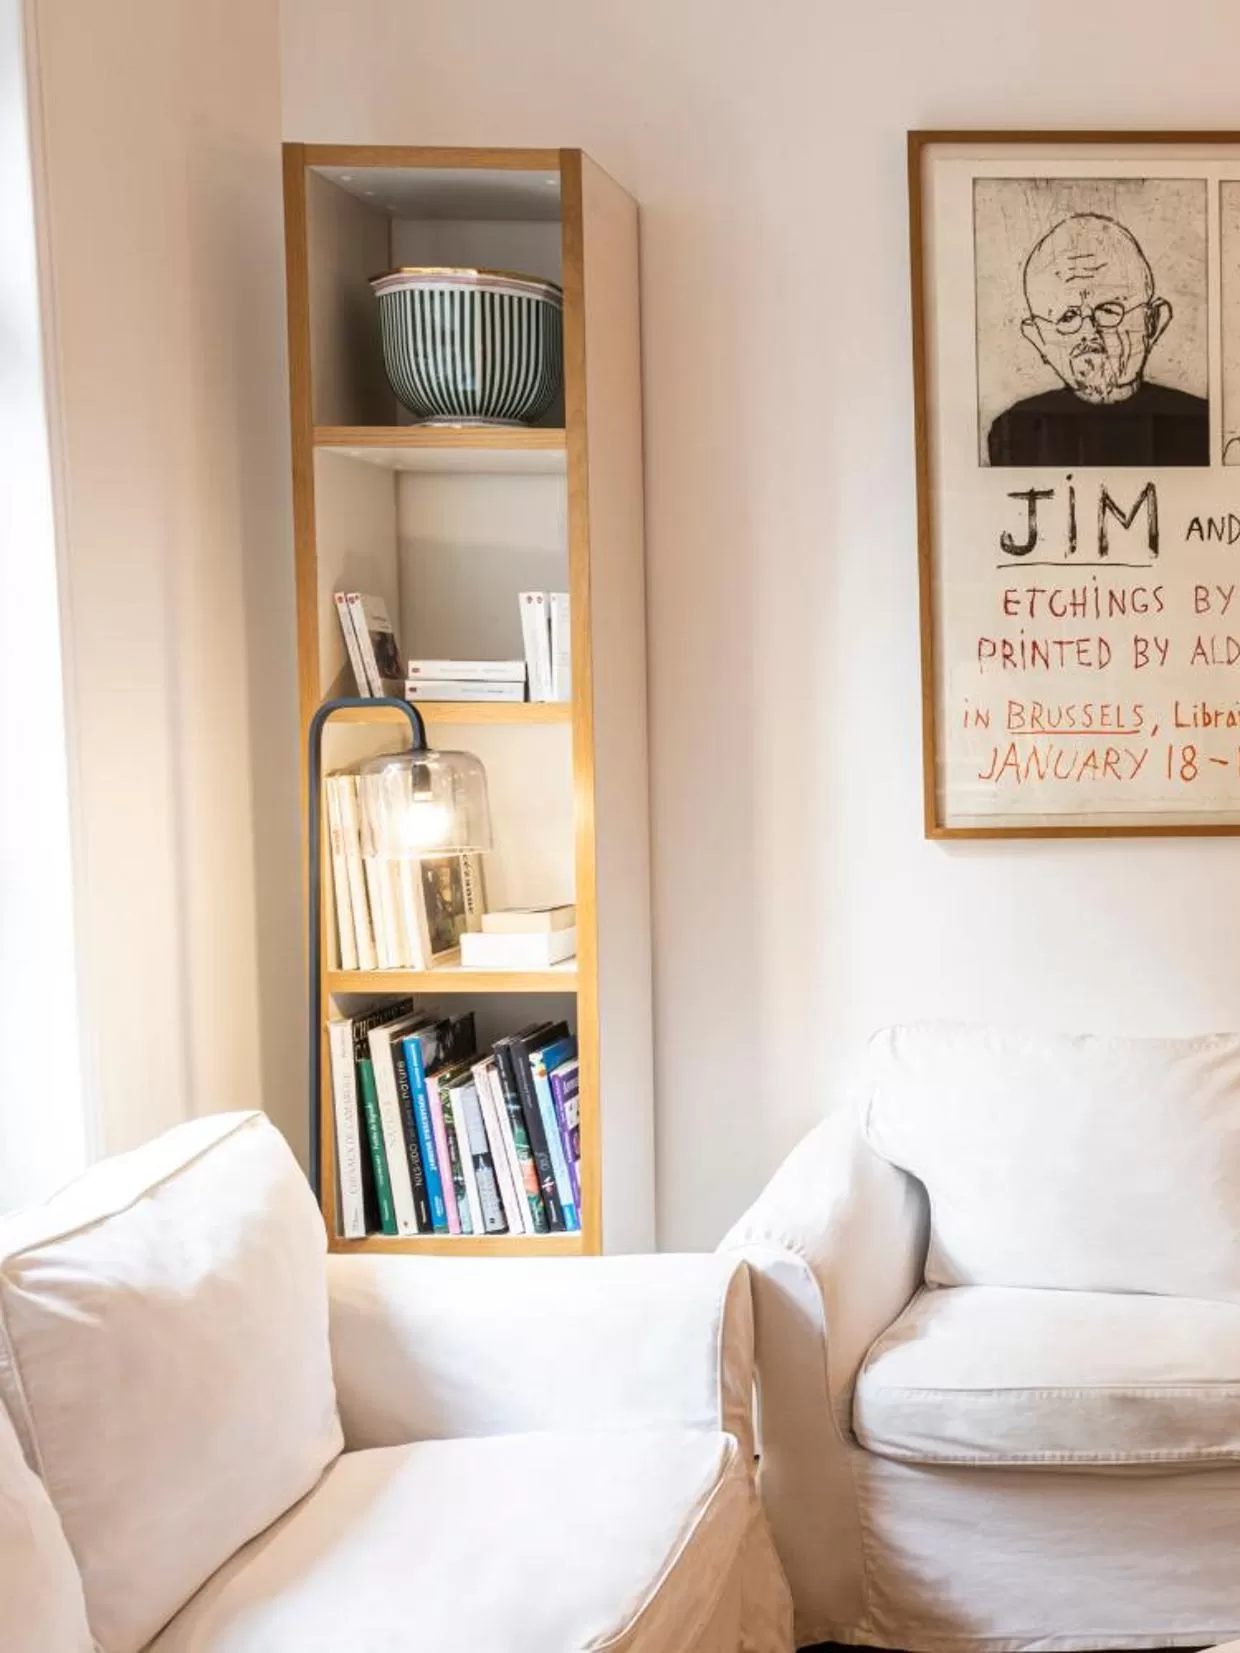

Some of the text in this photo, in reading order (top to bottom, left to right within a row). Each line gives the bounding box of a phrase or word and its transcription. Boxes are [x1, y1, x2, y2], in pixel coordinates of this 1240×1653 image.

[1194, 584, 1236, 616] BY
[1133, 636, 1171, 669] BY
[978, 741, 1149, 785] JANUARY
